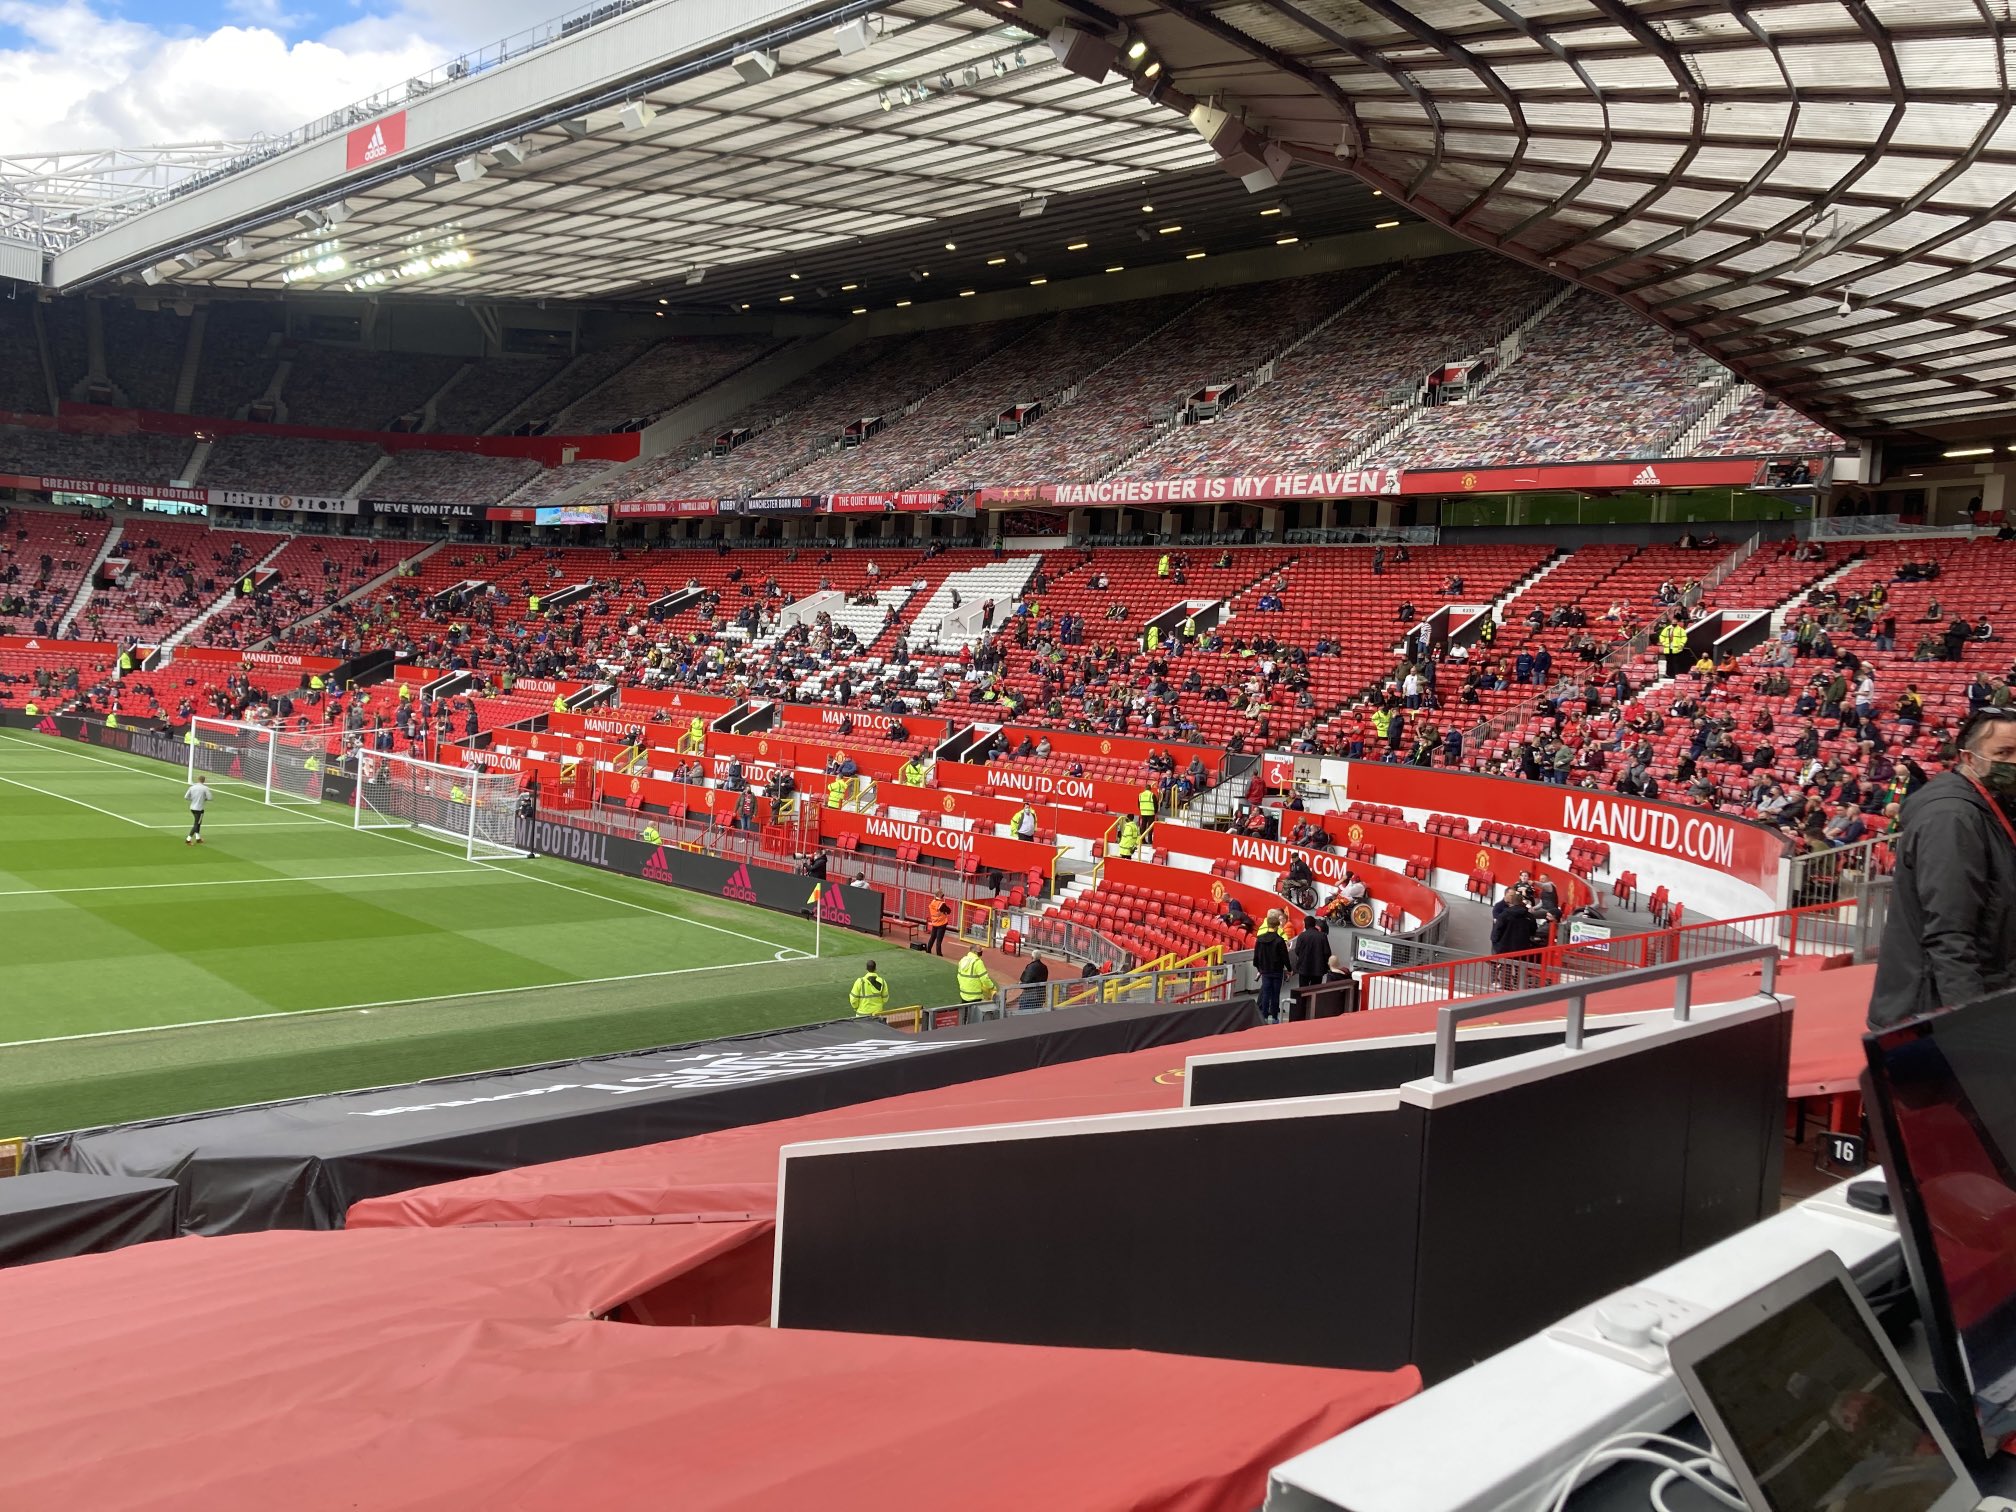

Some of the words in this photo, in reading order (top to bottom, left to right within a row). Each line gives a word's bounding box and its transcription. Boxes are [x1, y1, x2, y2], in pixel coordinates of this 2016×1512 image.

[42, 477, 95, 491] GREATEST
[97, 479, 110, 493] OF
[112, 481, 154, 496] ENGLISH
[157, 487, 205, 501] FOOTBALL
[1055, 478, 1196, 502] MANCHESTER
[1204, 478, 1227, 498] IS
[1233, 475, 1273, 497] MY
[1274, 471, 1379, 495] HEAVEN
[1632, 477, 1661, 485] adidas
[373, 502, 409, 513] WE'VE
[412, 505, 439, 515] WON
[439, 505, 450, 515] IT
[452, 506, 473, 516] ALL
[748, 499, 779, 510] MANCHESTER
[778, 499, 791, 509] BORN
[838, 496, 849, 507] THE
[850, 495, 867, 506] QUIET
[868, 494, 883, 506] MAN
[901, 494, 918, 505] TONY
[241, 651, 302, 666] MANUTD.COM
[987, 769, 1093, 799] MANUTD.COM
[866, 817, 974, 853] MANUTD.COM
[1563, 795, 1735, 868] MANUTD.COM
[642, 864, 673, 883] adidas
[722, 882, 757, 903] adidas
[1833, 1140, 1855, 1162] 16
